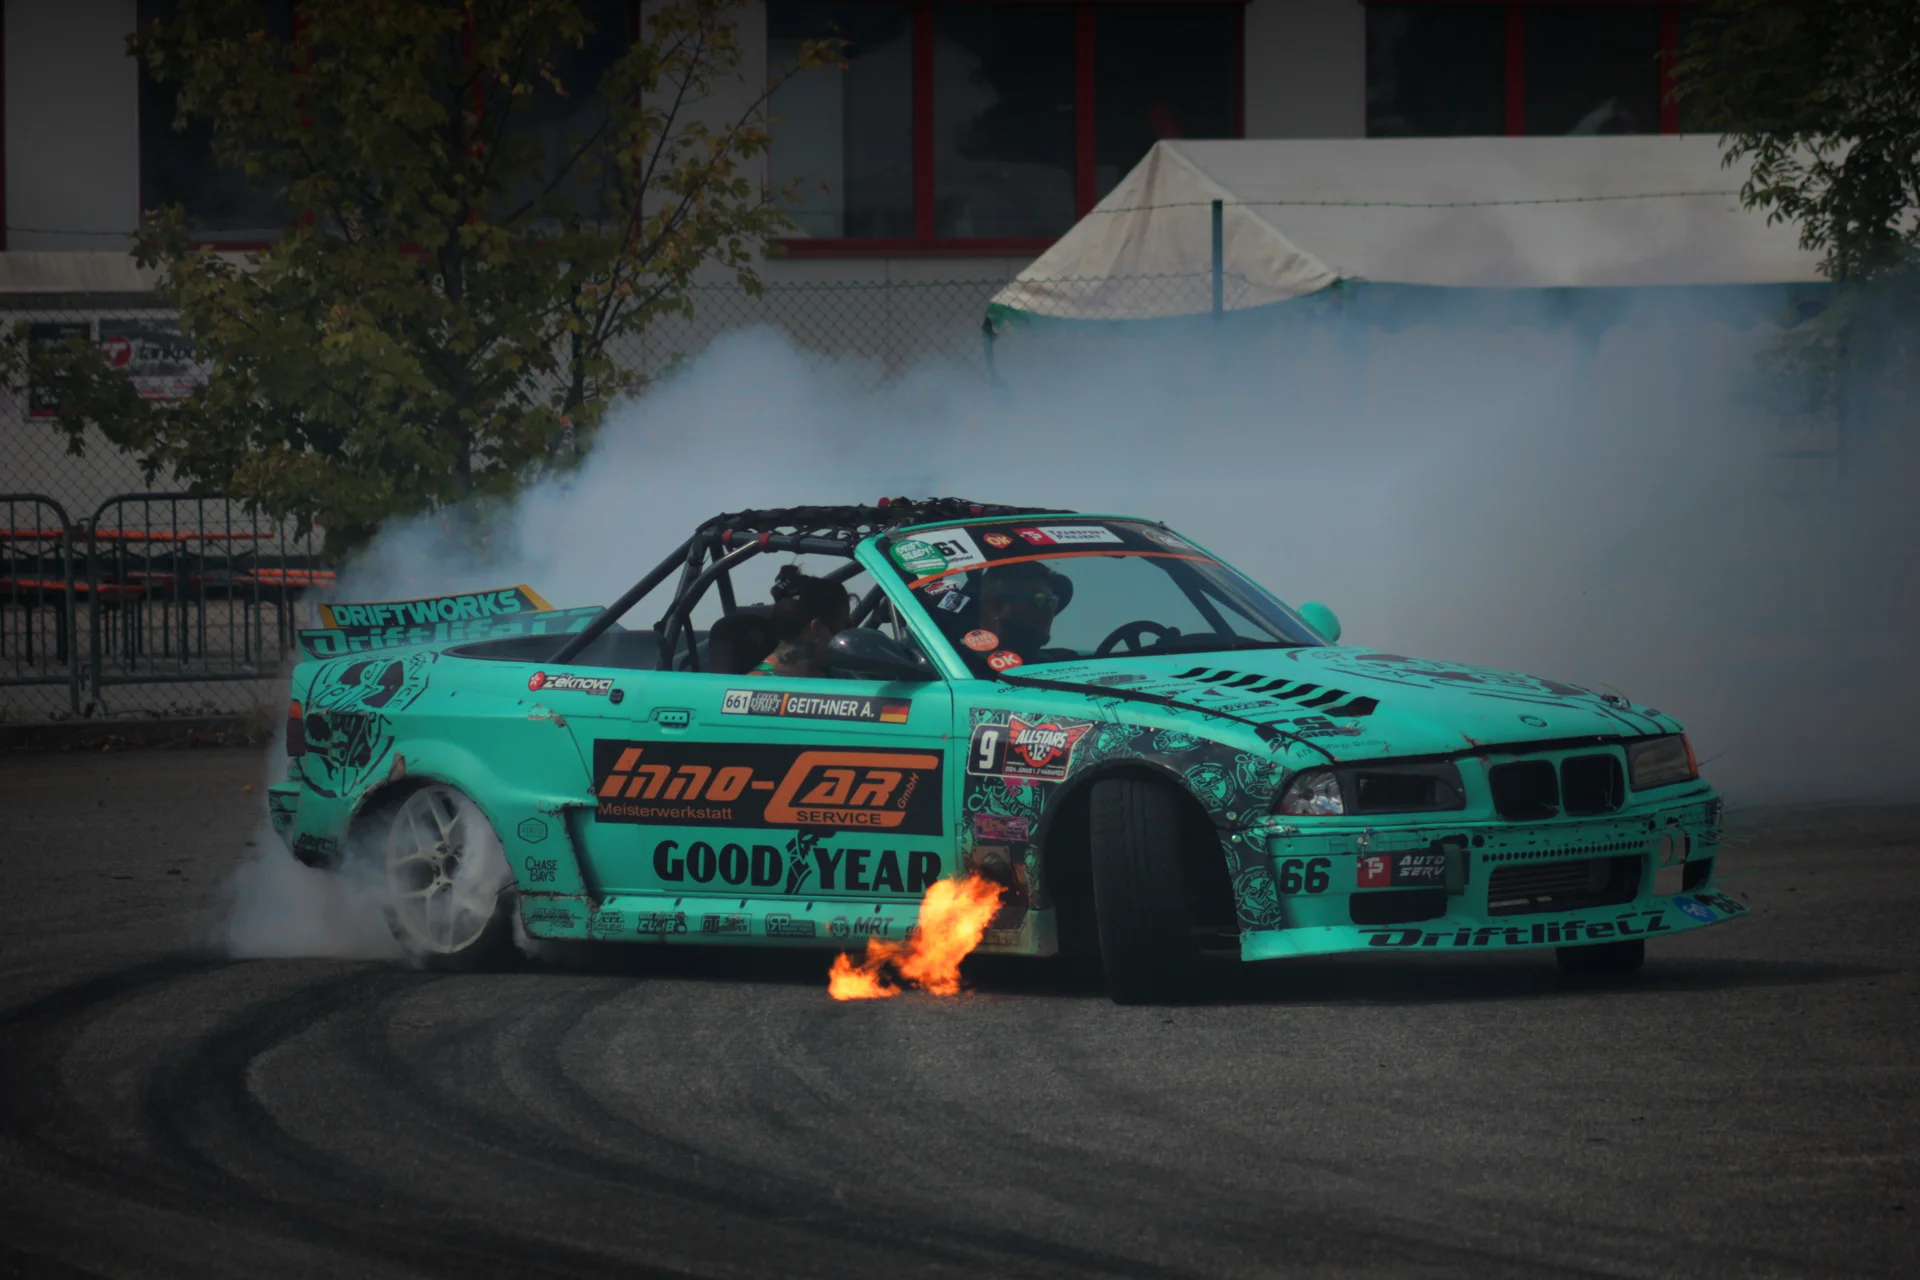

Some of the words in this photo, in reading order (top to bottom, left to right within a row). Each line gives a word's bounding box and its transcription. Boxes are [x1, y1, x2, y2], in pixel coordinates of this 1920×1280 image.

[986, 533, 1011, 548] OK
[330, 589, 522, 627] DRIFTWORKS
[990, 653, 1020, 669] OK
[725, 693, 749, 710] 661
[750, 698, 782, 708] DRIFT
[787, 696, 857, 717] GEITHNER
[860, 702, 875, 718] A.
[1014, 728, 1069, 749] ALLSTARS
[978, 730, 999, 769] 9
[1031, 744, 1044, 761] 12
[897, 772, 920, 810] GmbH
[597, 802, 733, 820] Meisterwerkstatt
[796, 809, 882, 825] SERVICE
[525, 856, 558, 871] CHASE
[652, 839, 783, 888] GOOD
[812, 846, 942, 895] YEAR
[1399, 854, 1445, 867] AUTO
[530, 868, 556, 882] BAYS
[1280, 857, 1331, 895] 66
[853, 916, 894, 935] MRT
